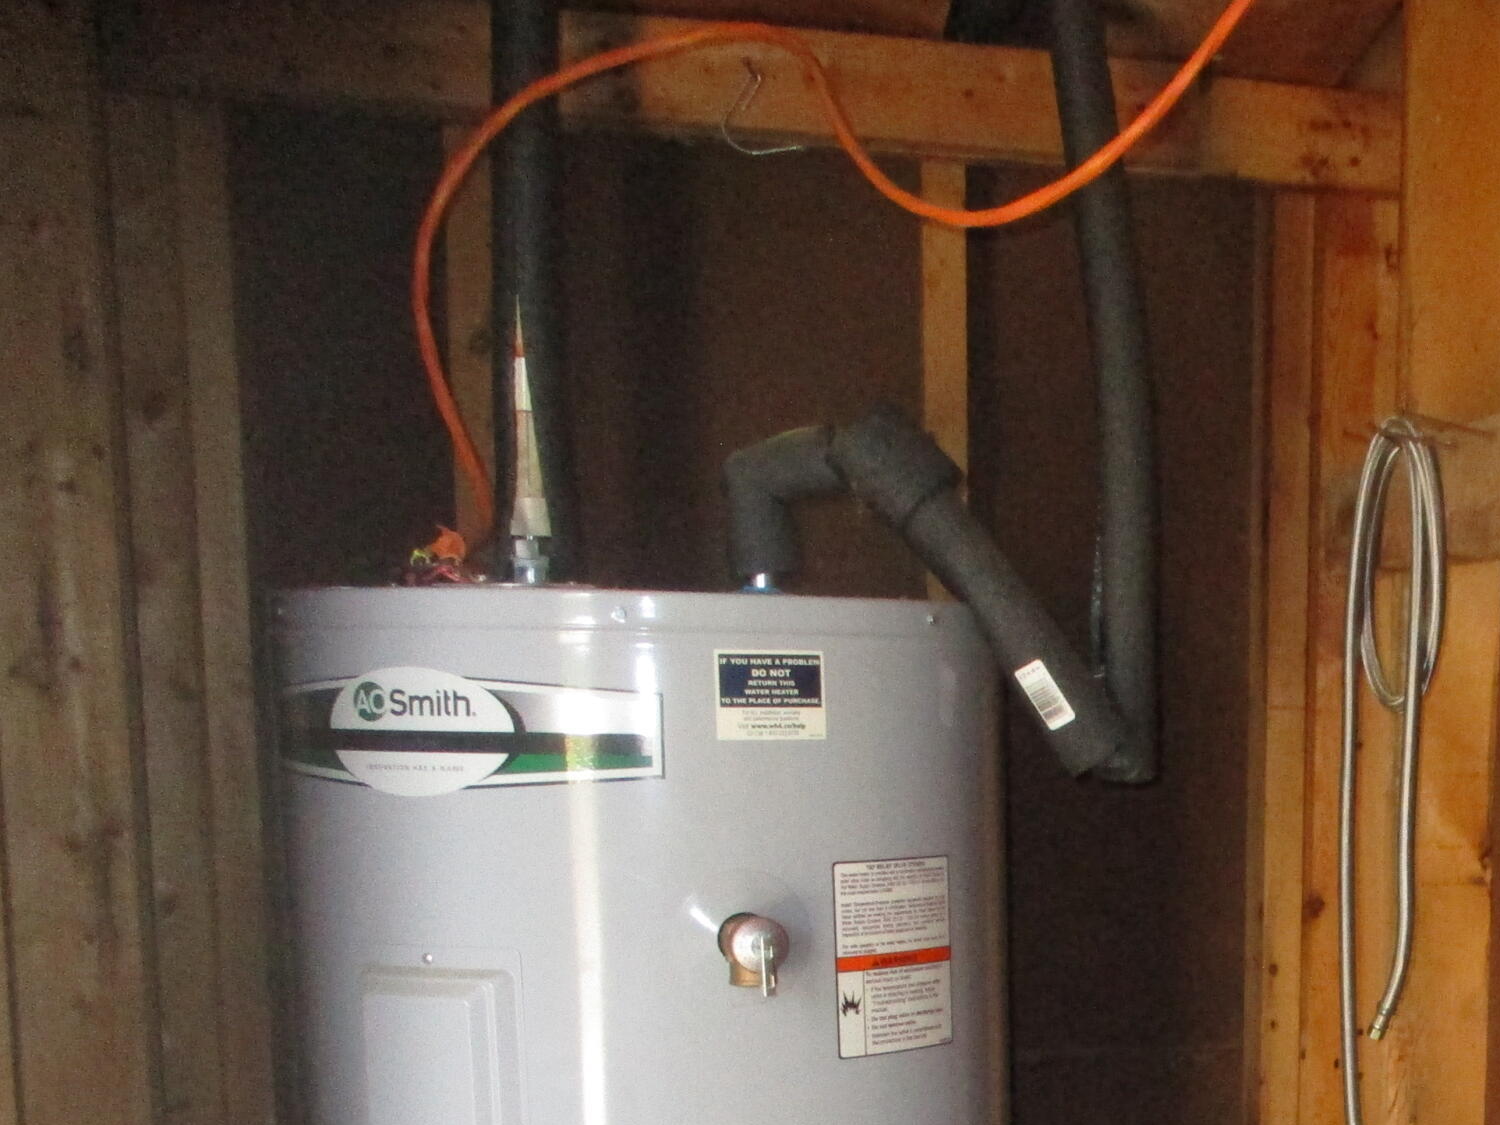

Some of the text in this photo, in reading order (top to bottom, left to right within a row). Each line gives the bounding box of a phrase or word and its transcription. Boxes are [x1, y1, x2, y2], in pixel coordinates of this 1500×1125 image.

[782, 658, 820, 666] PROBLEM
[751, 669, 791, 677] DO NOT
[390, 689, 471, 717] Smith
